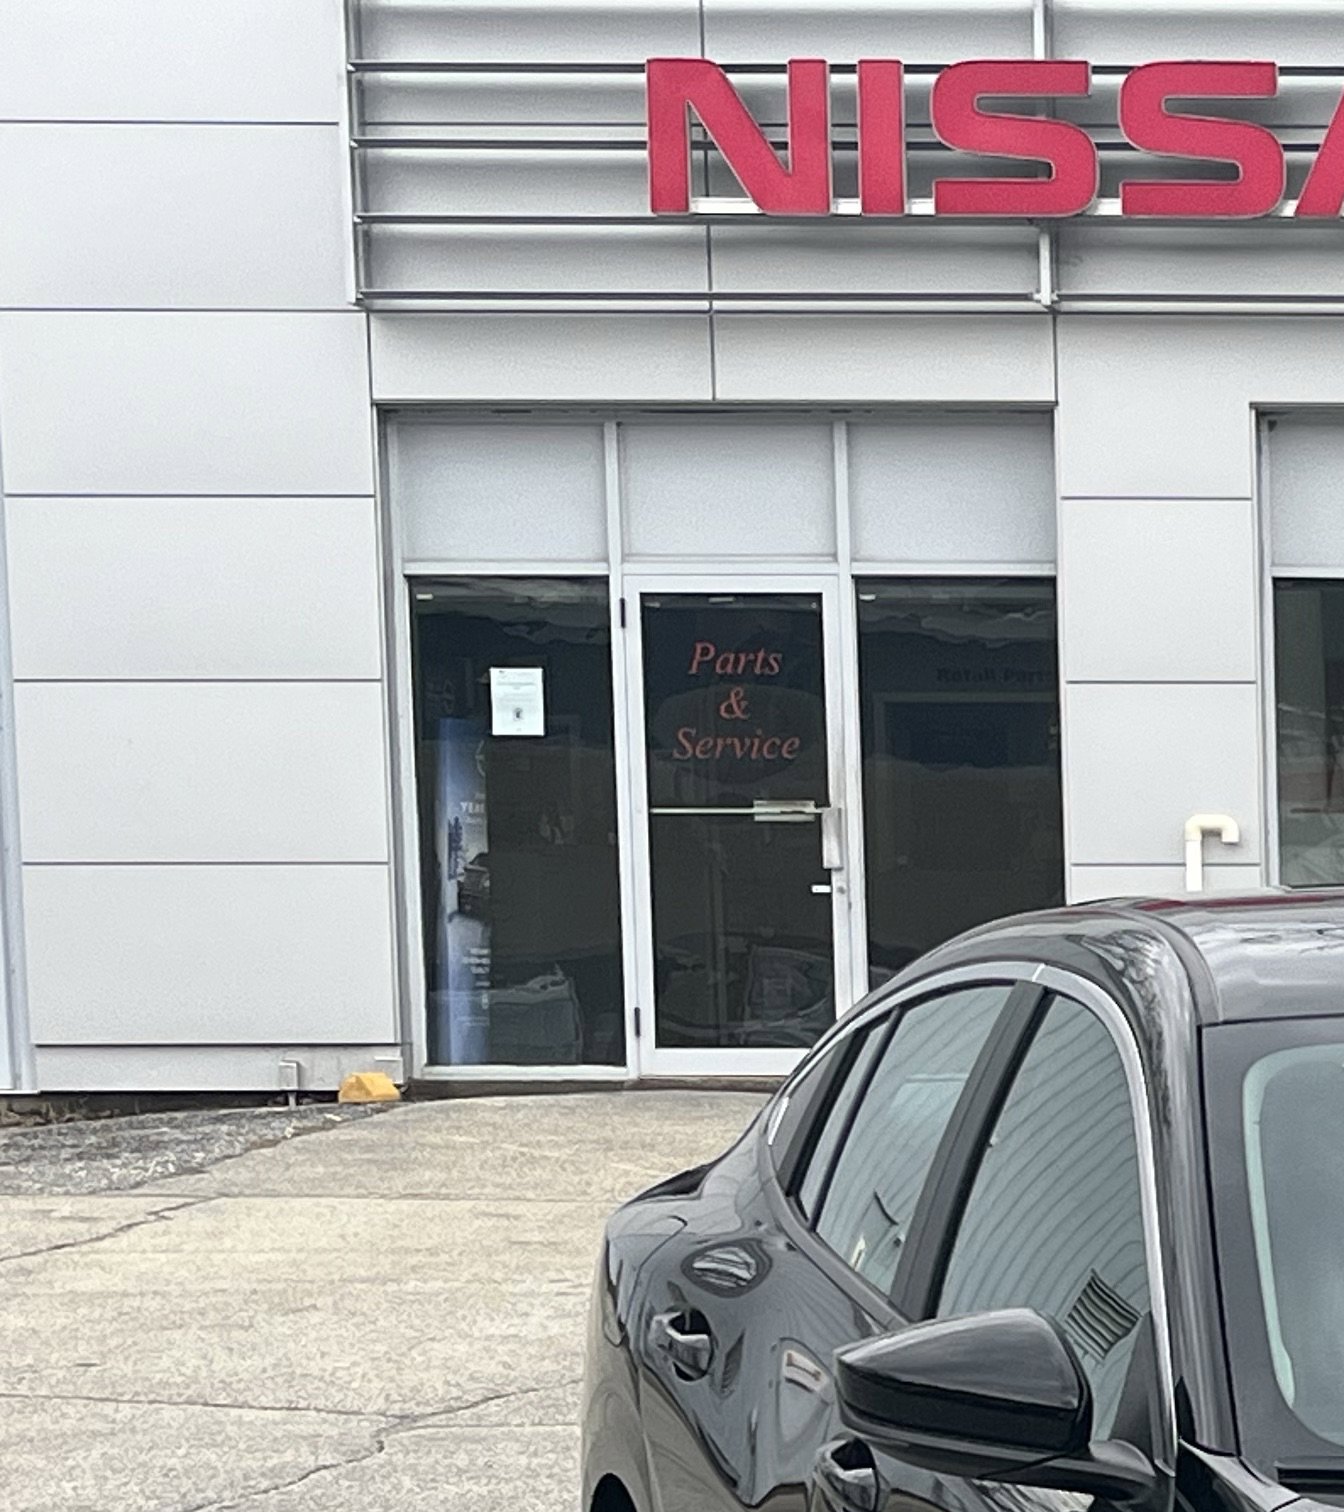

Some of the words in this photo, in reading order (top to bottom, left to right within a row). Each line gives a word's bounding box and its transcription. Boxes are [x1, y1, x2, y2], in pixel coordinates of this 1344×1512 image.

[687, 640, 783, 676] Parts
[718, 686, 749, 721] &
[672, 727, 801, 760] Service
